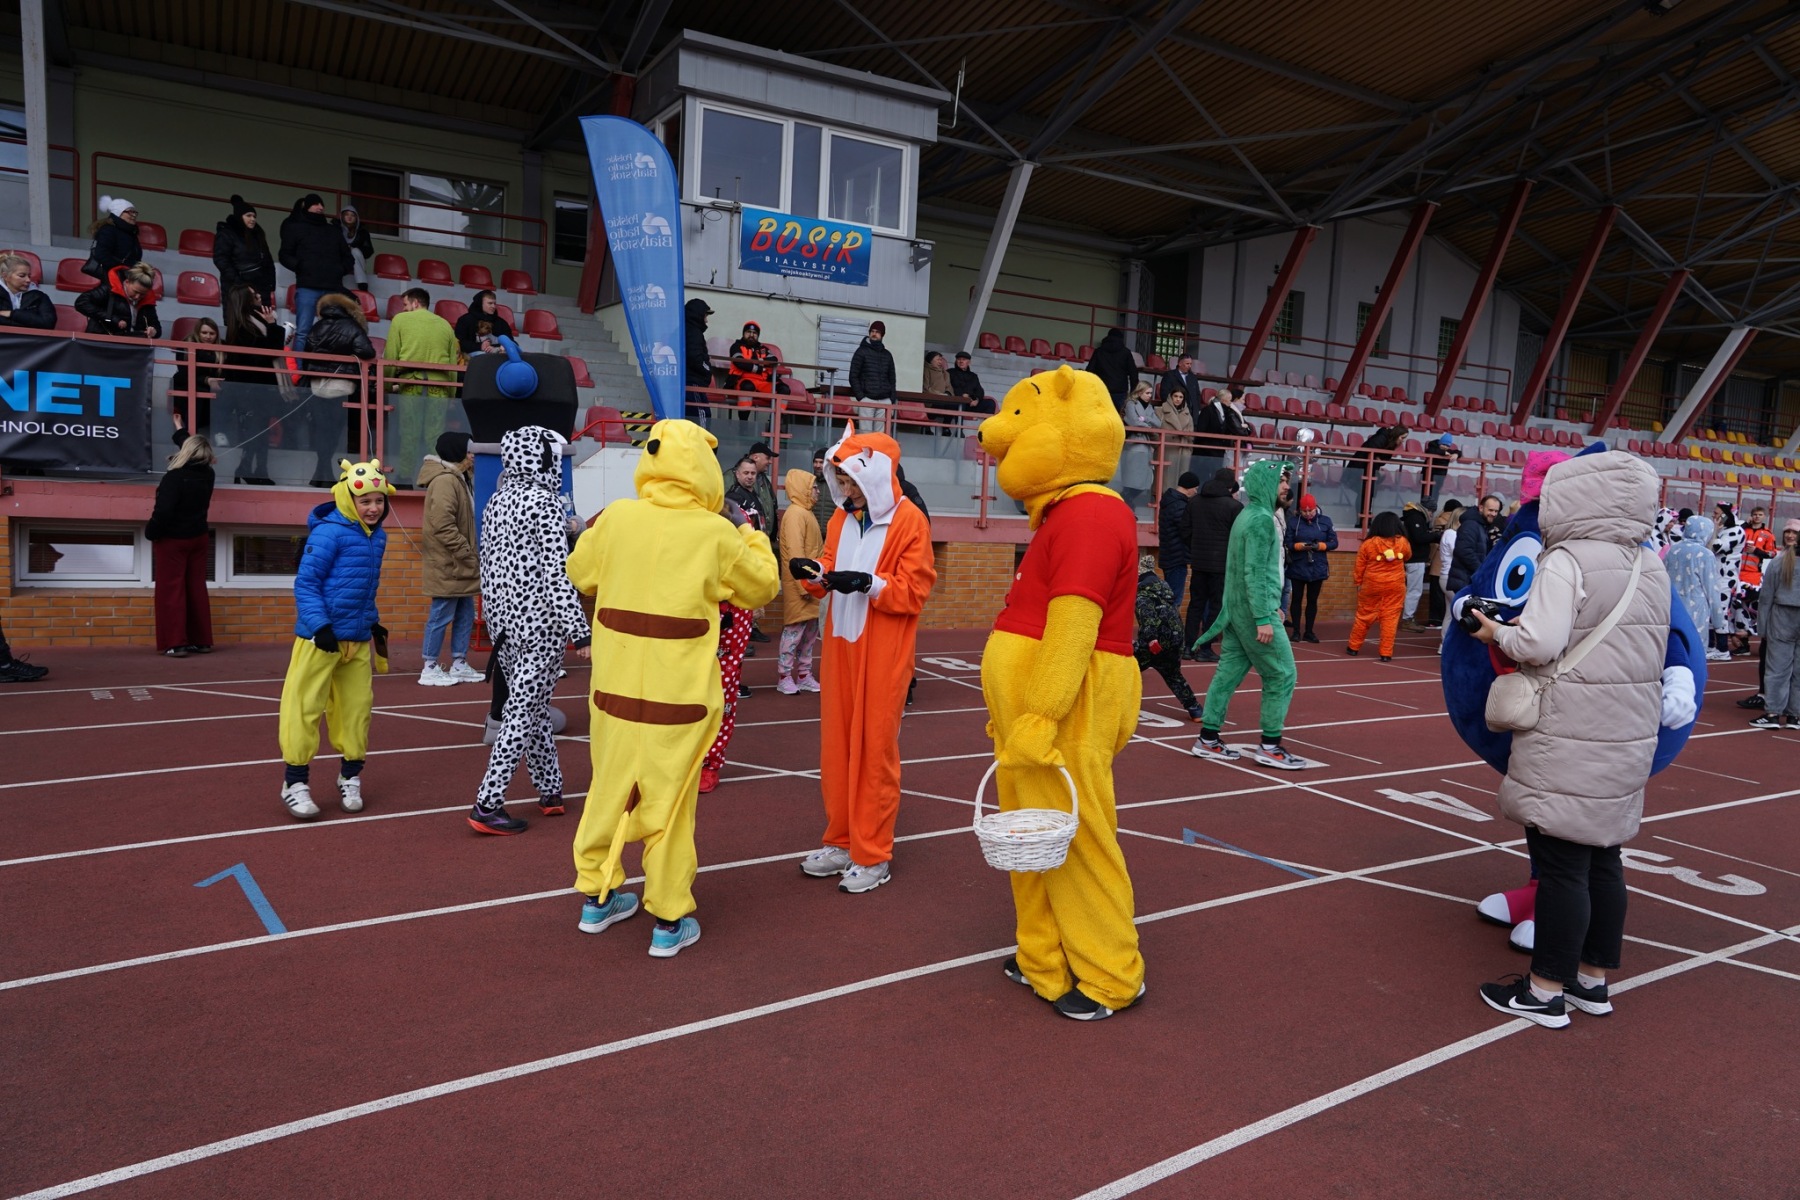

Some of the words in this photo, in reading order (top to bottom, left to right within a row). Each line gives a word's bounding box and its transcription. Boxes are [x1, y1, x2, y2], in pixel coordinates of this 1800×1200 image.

[764, 255, 847, 274] BIAŁYSTOK
[1373, 788, 1495, 822] 4
[1620, 847, 1767, 896] 3
